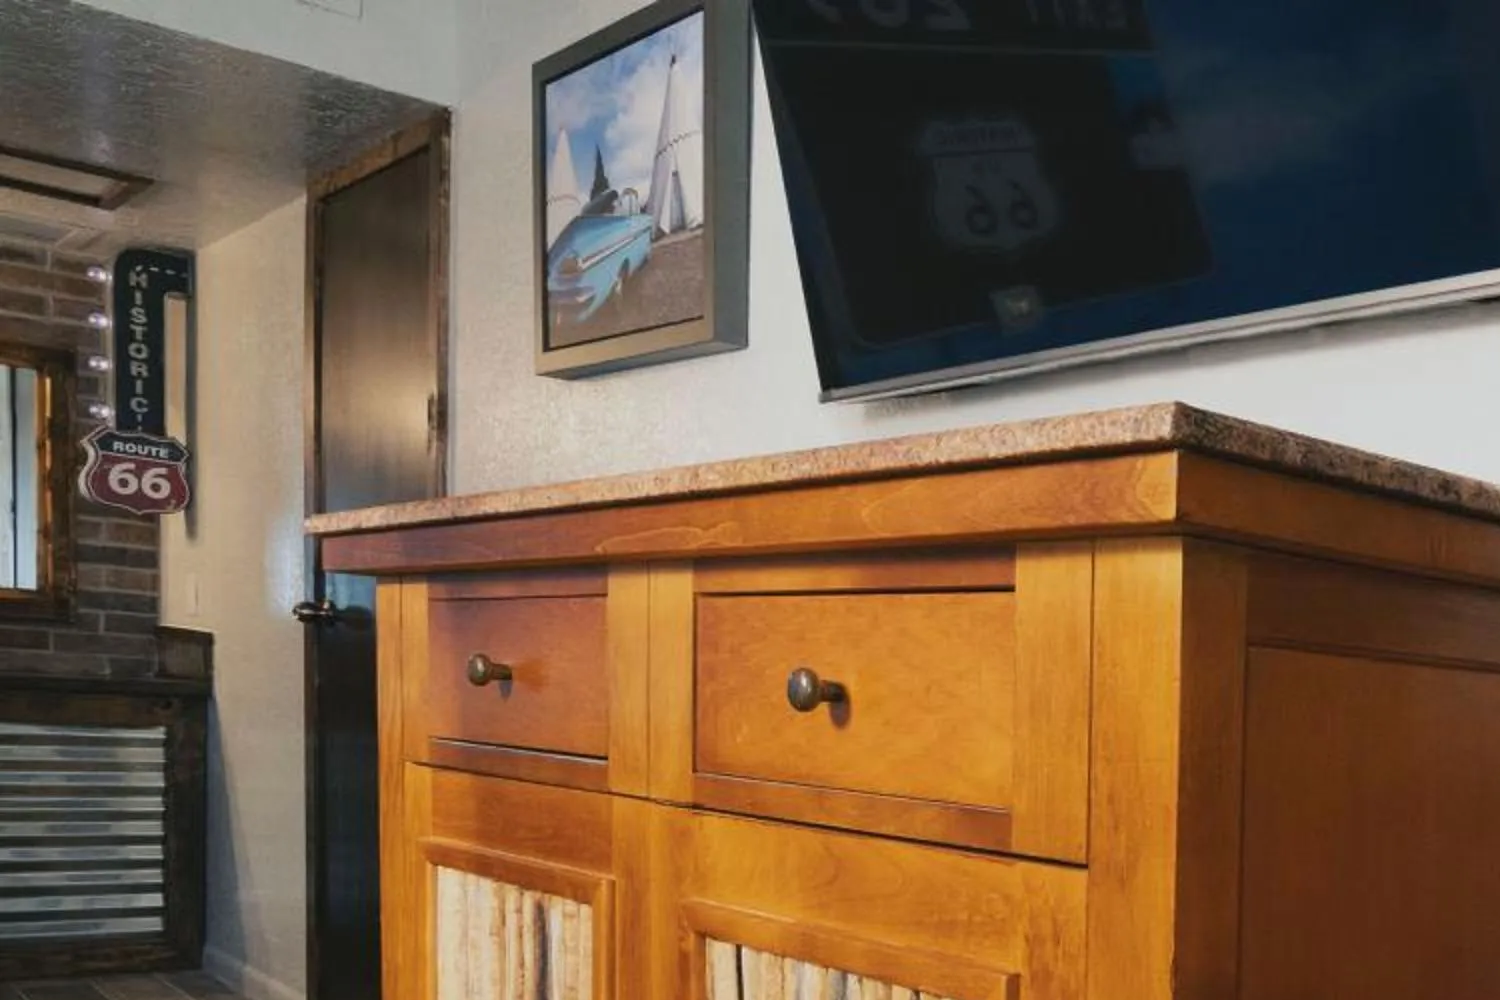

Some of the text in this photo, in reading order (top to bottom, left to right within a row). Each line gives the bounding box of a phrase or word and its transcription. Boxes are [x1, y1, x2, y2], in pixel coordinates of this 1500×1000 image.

[129, 269, 149, 414] HISTORIC
[112, 441, 169, 459] ROUTE
[107, 461, 171, 500] 66
